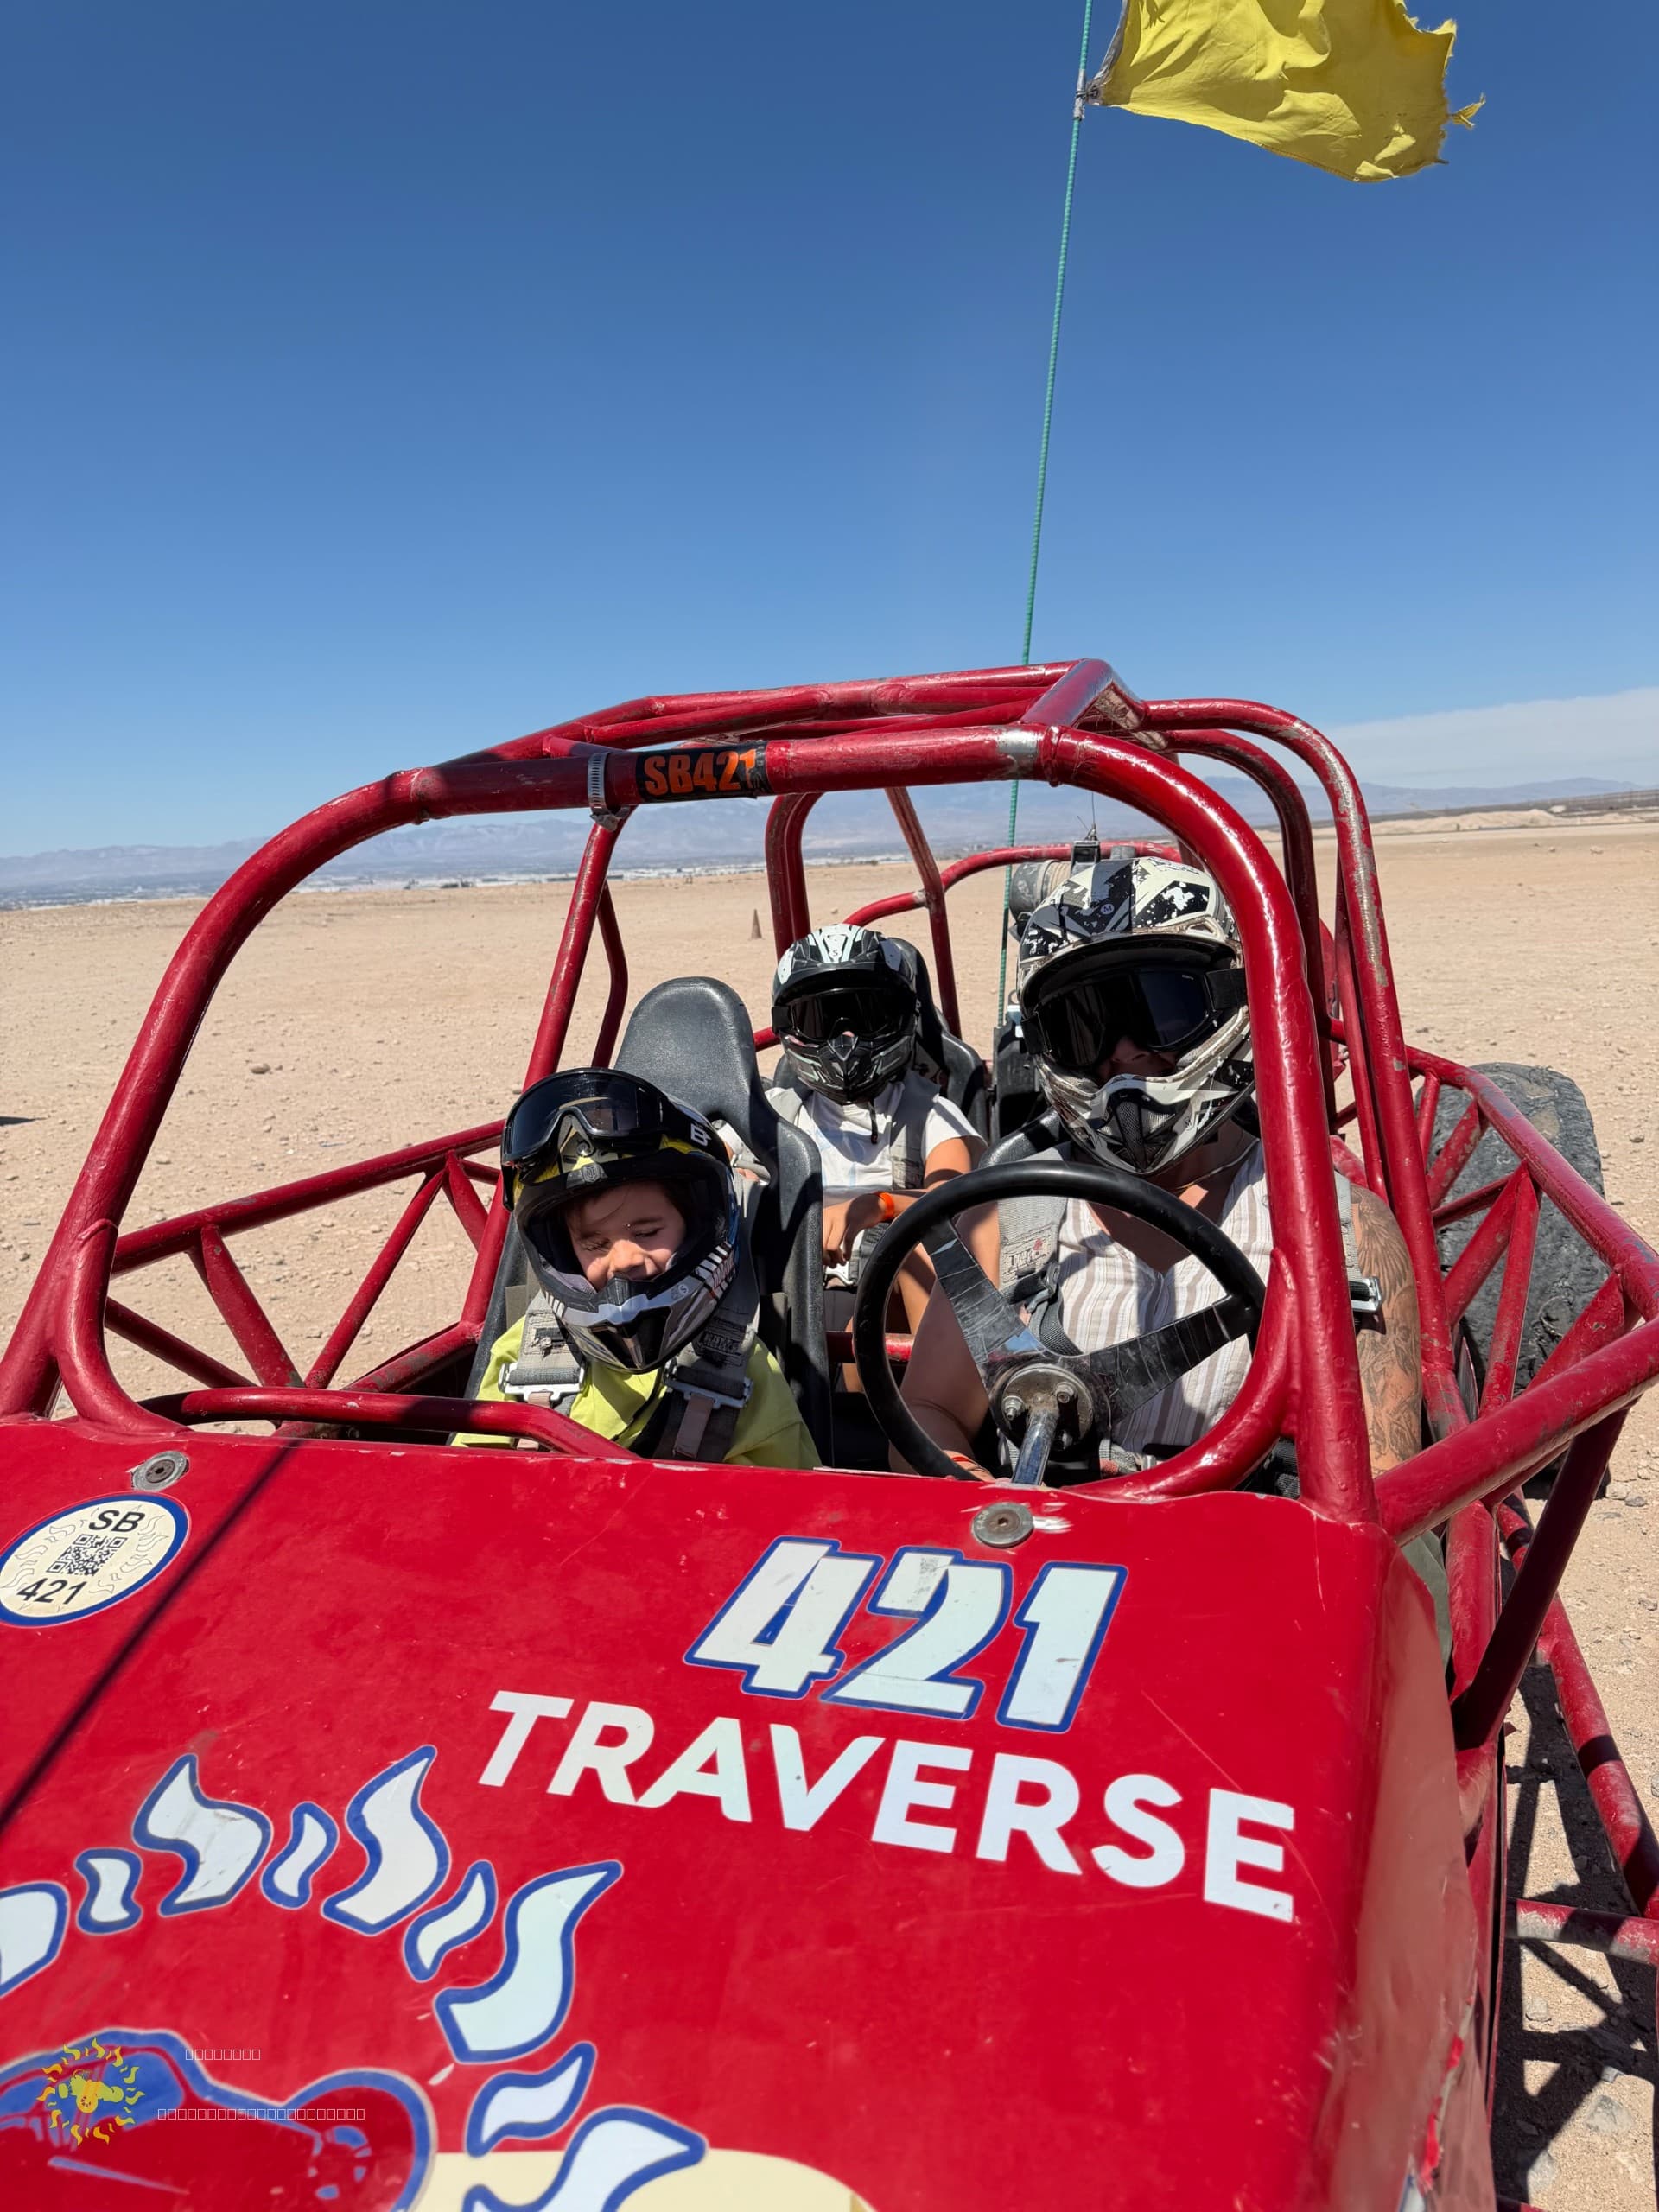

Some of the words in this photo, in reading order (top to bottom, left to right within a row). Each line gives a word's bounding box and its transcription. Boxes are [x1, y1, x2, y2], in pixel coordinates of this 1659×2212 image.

[644, 748, 757, 796] SB421
[88, 1509, 146, 1533] SB
[16, 1577, 87, 1605] 421
[683, 1535, 1128, 1733] 421
[479, 1690, 1295, 1923] TRAVERSE
